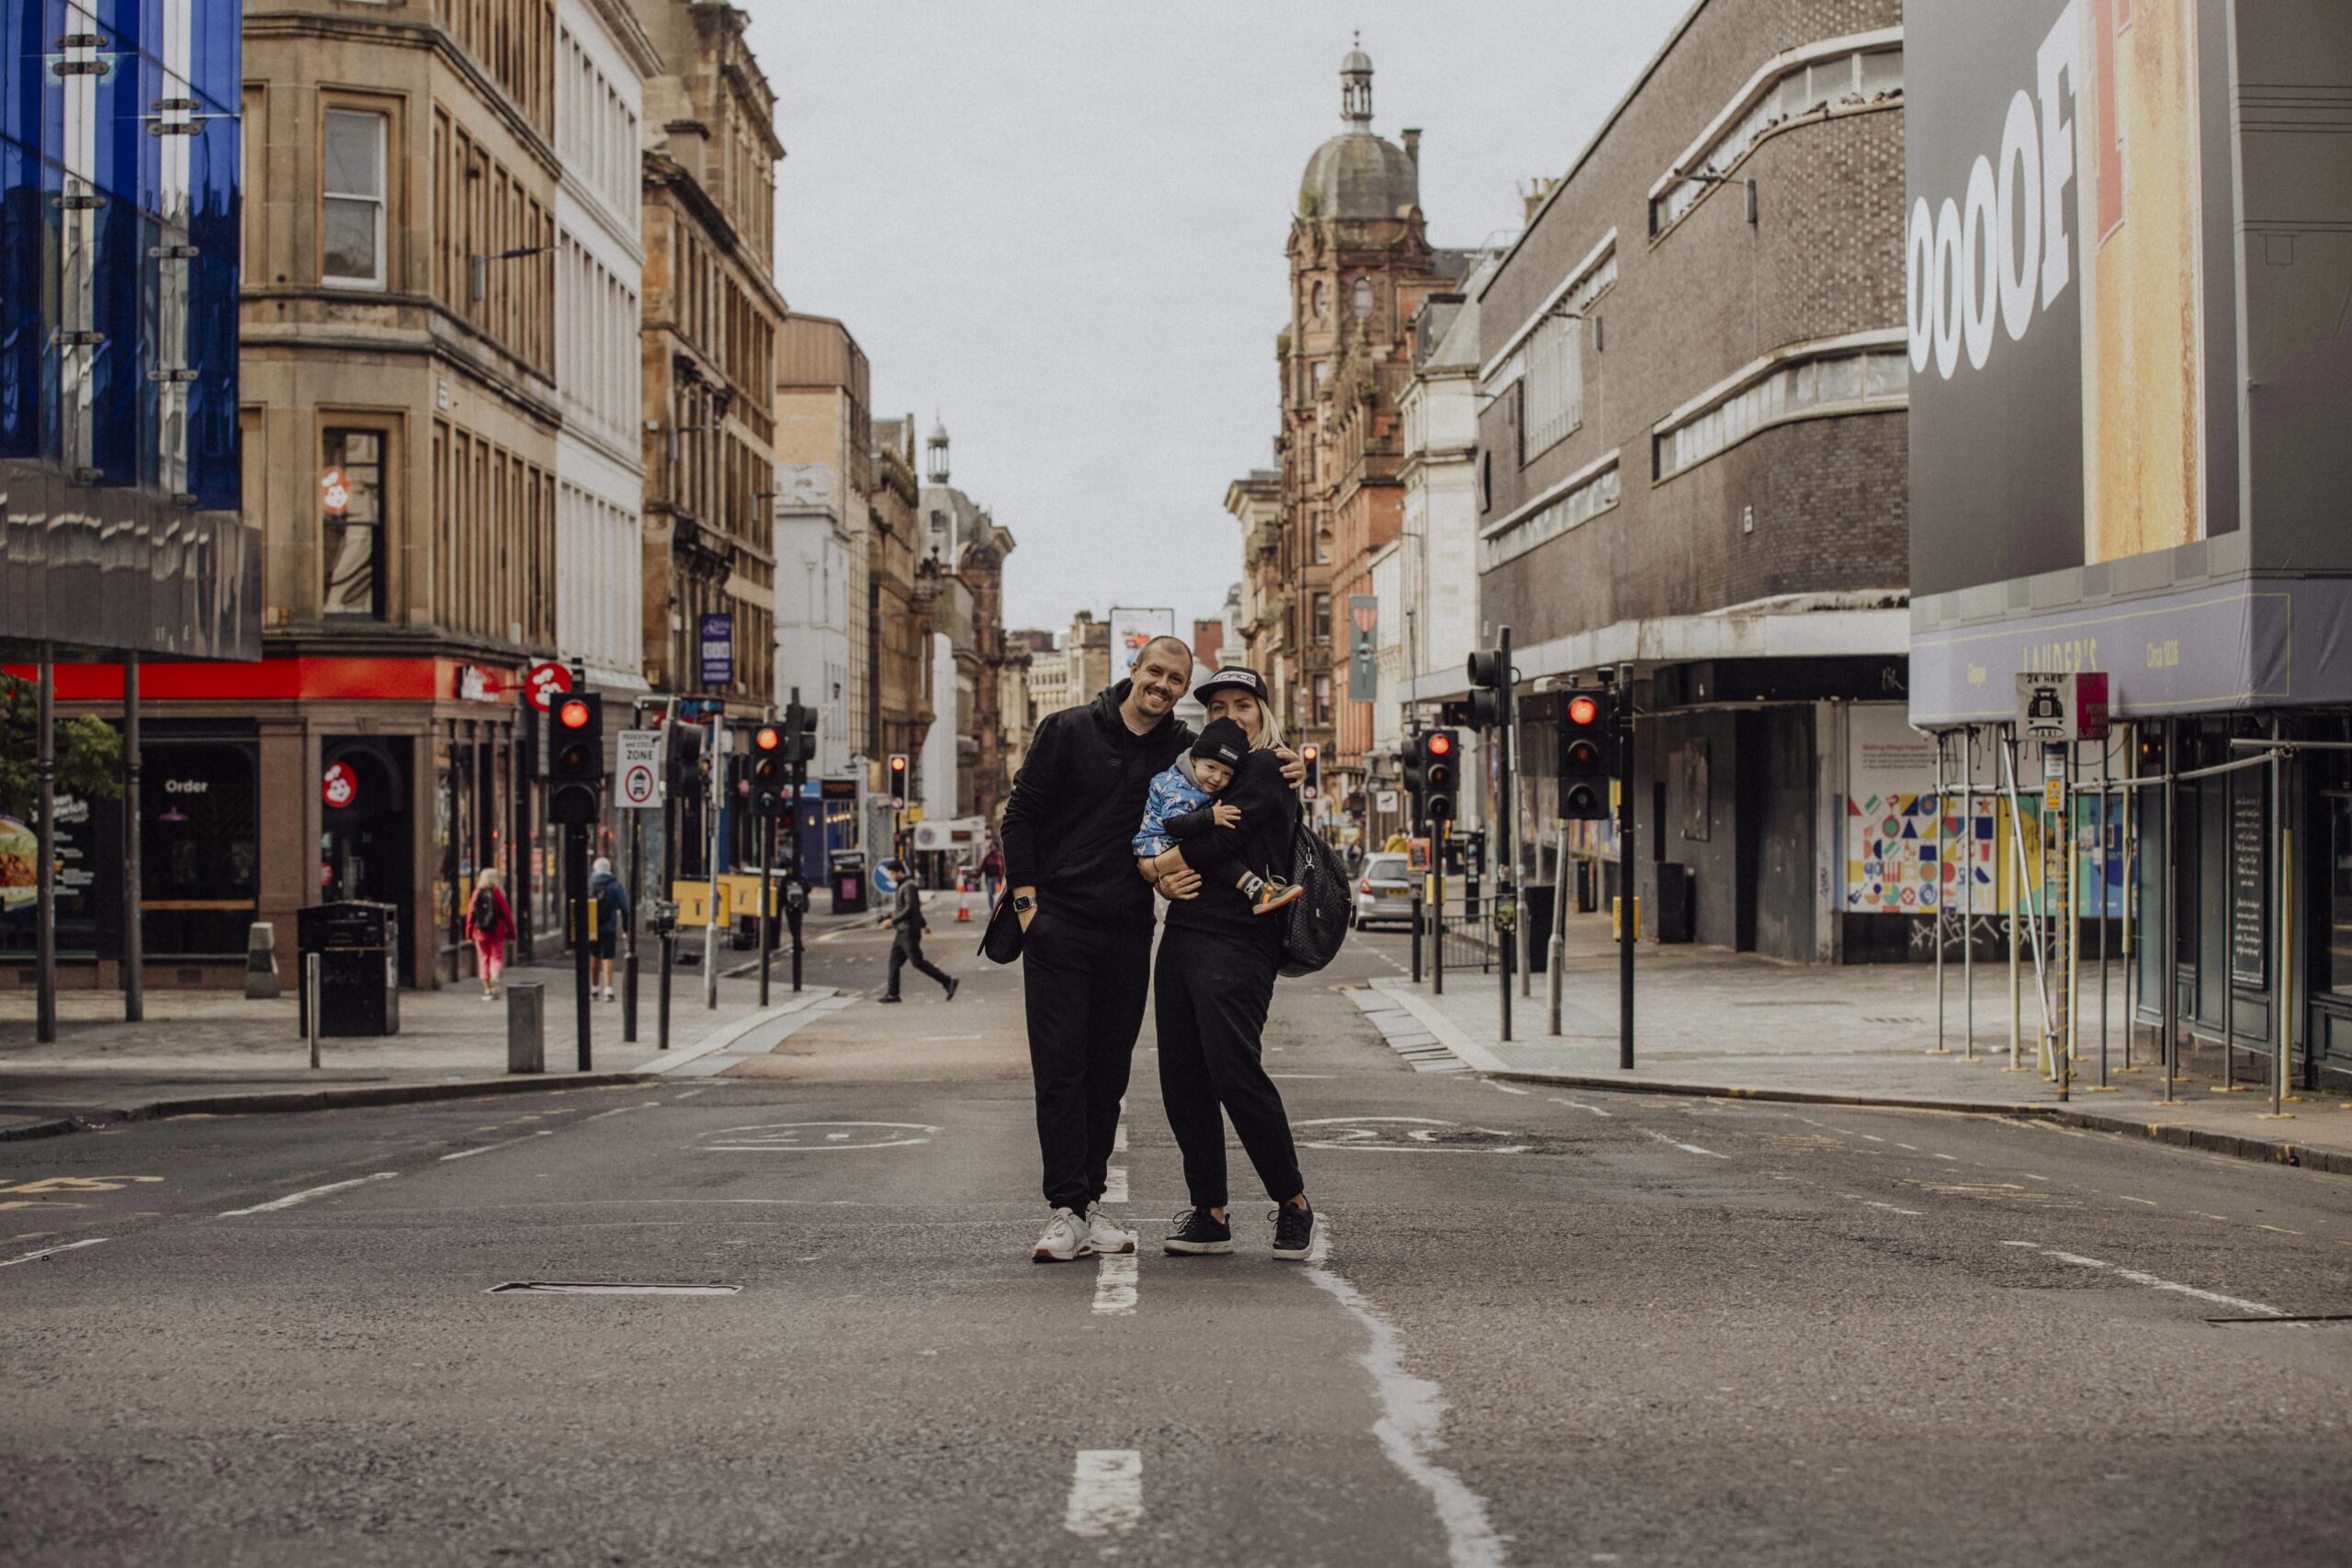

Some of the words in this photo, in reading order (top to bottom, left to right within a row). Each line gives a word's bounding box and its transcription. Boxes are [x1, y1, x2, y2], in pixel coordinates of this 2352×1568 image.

[2027, 673, 2039, 683] 24
[2044, 673, 2064, 683] HRS
[2034, 728, 2058, 738] TAXI
[627, 750, 653, 761] ZONE
[165, 779, 209, 793] Order
